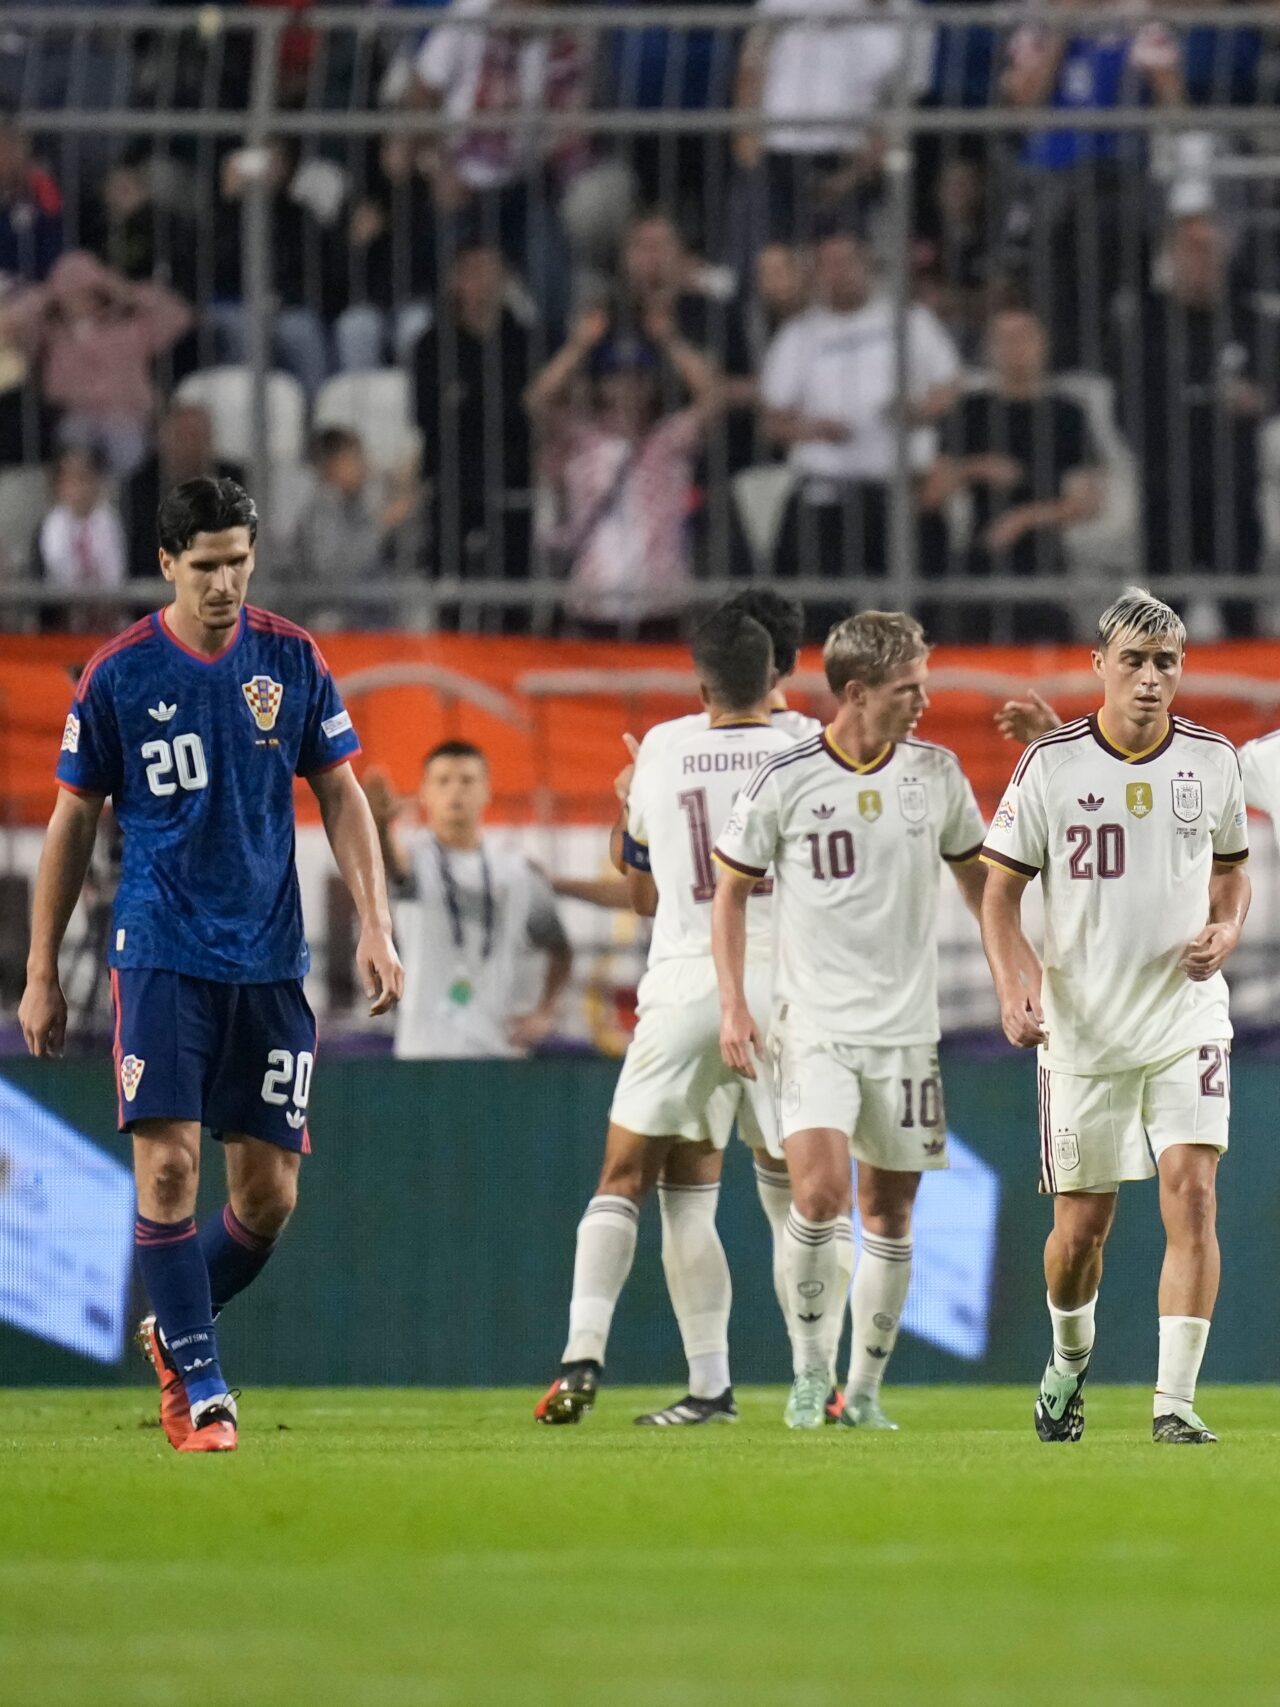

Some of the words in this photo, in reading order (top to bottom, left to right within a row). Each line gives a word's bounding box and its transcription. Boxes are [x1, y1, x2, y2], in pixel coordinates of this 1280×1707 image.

[142, 732, 208, 796] 20
[807, 829, 855, 880] 10
[1066, 823, 1126, 880] 20
[261, 1048, 314, 1109] 20
[1198, 1044, 1230, 1098] 2
[900, 1077, 943, 1128] 10
